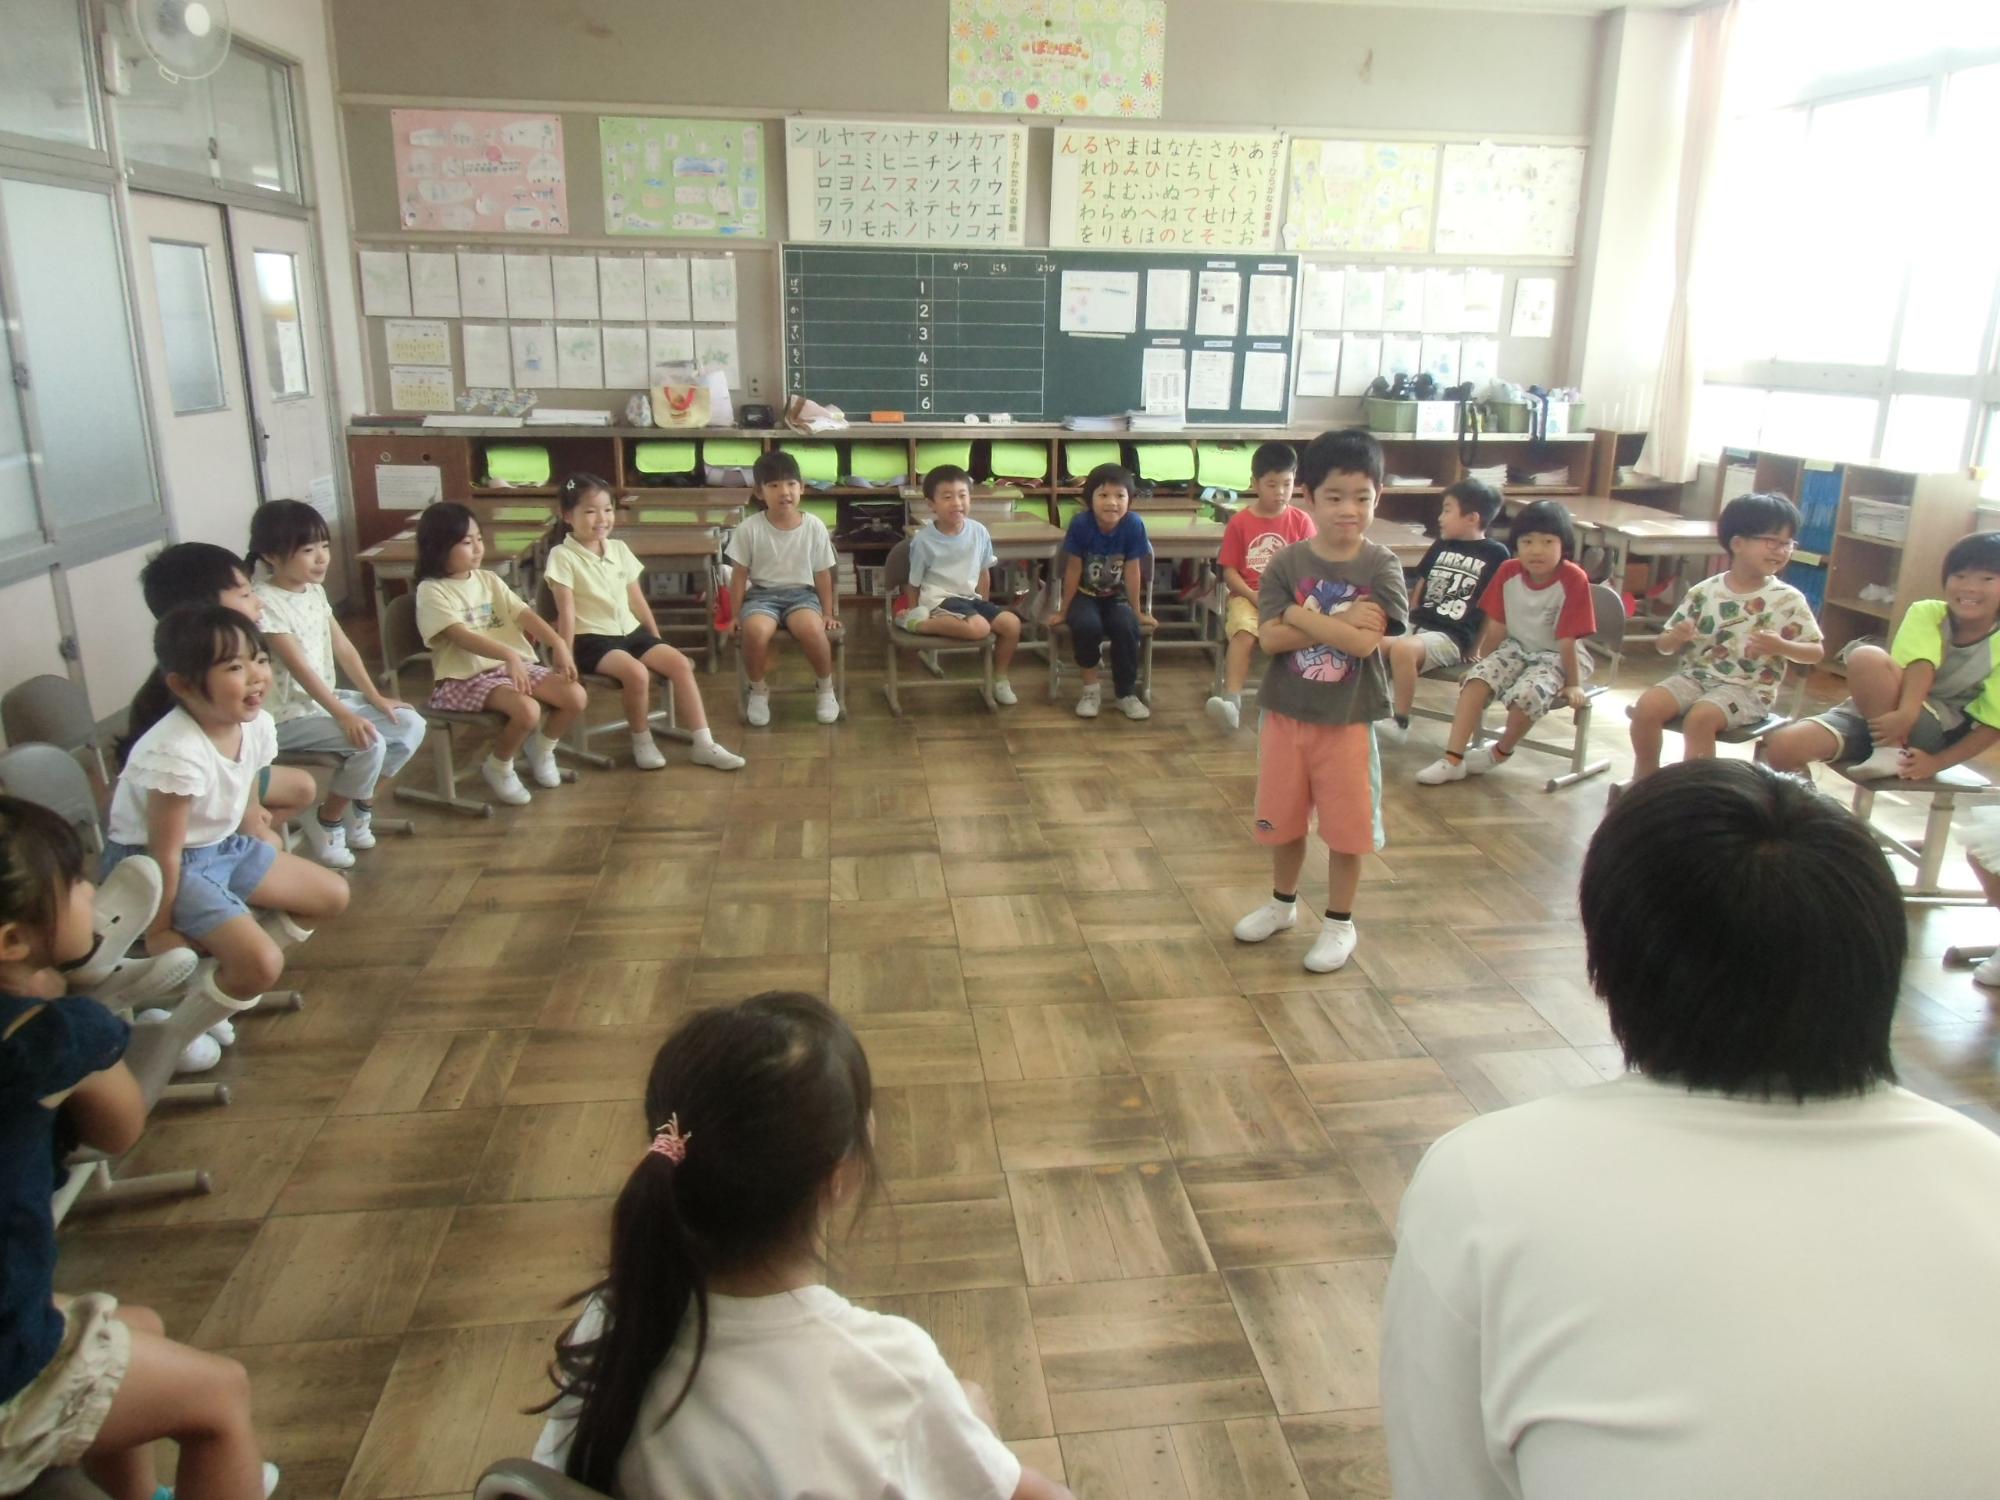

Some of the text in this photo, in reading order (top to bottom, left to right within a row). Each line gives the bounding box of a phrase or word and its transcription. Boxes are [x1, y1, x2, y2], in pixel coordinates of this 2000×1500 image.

[919, 280, 925, 294] 1
[919, 304, 929, 318] 2
[918, 326, 928, 341] 3
[918, 351, 928, 364] 4
[919, 374, 929, 387] 5
[921, 397, 930, 410] 6
[1435, 550, 1486, 576] BREAK
